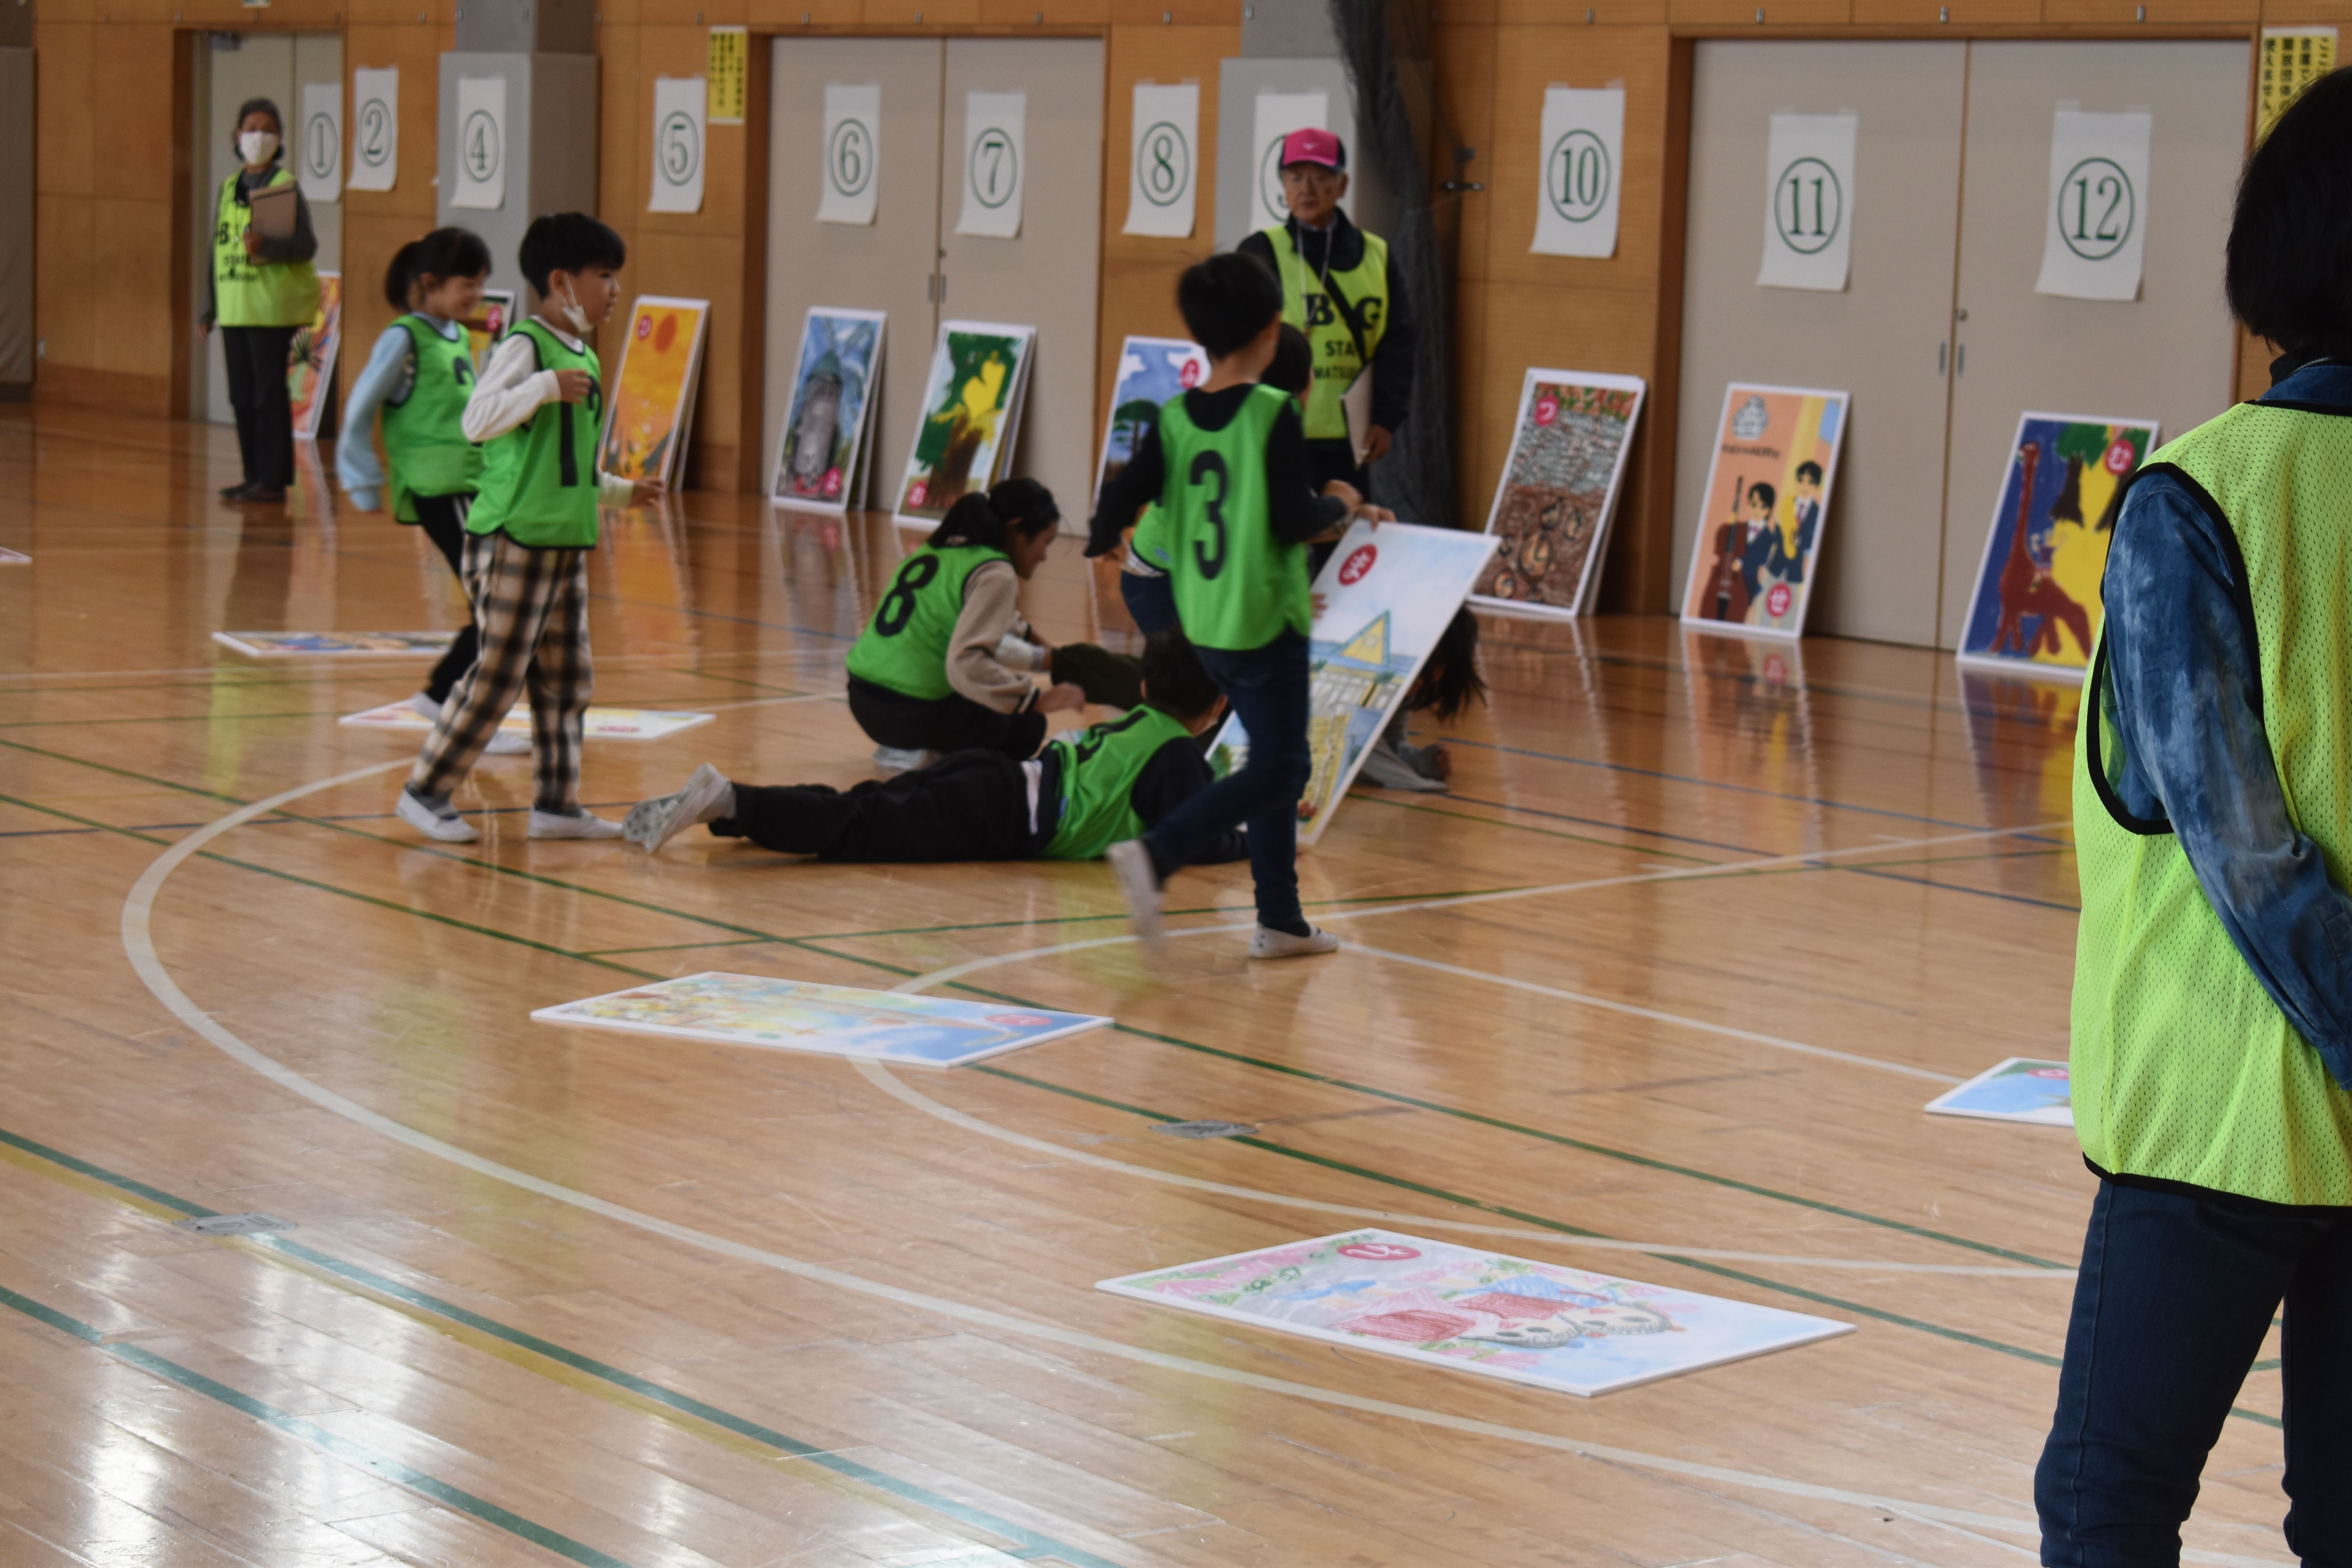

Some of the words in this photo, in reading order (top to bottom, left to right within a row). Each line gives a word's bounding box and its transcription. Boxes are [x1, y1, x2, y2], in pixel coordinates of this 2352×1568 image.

[1326, 340, 1355, 356] STA
[1189, 449, 1229, 580] 3
[875, 554, 939, 637] 8
